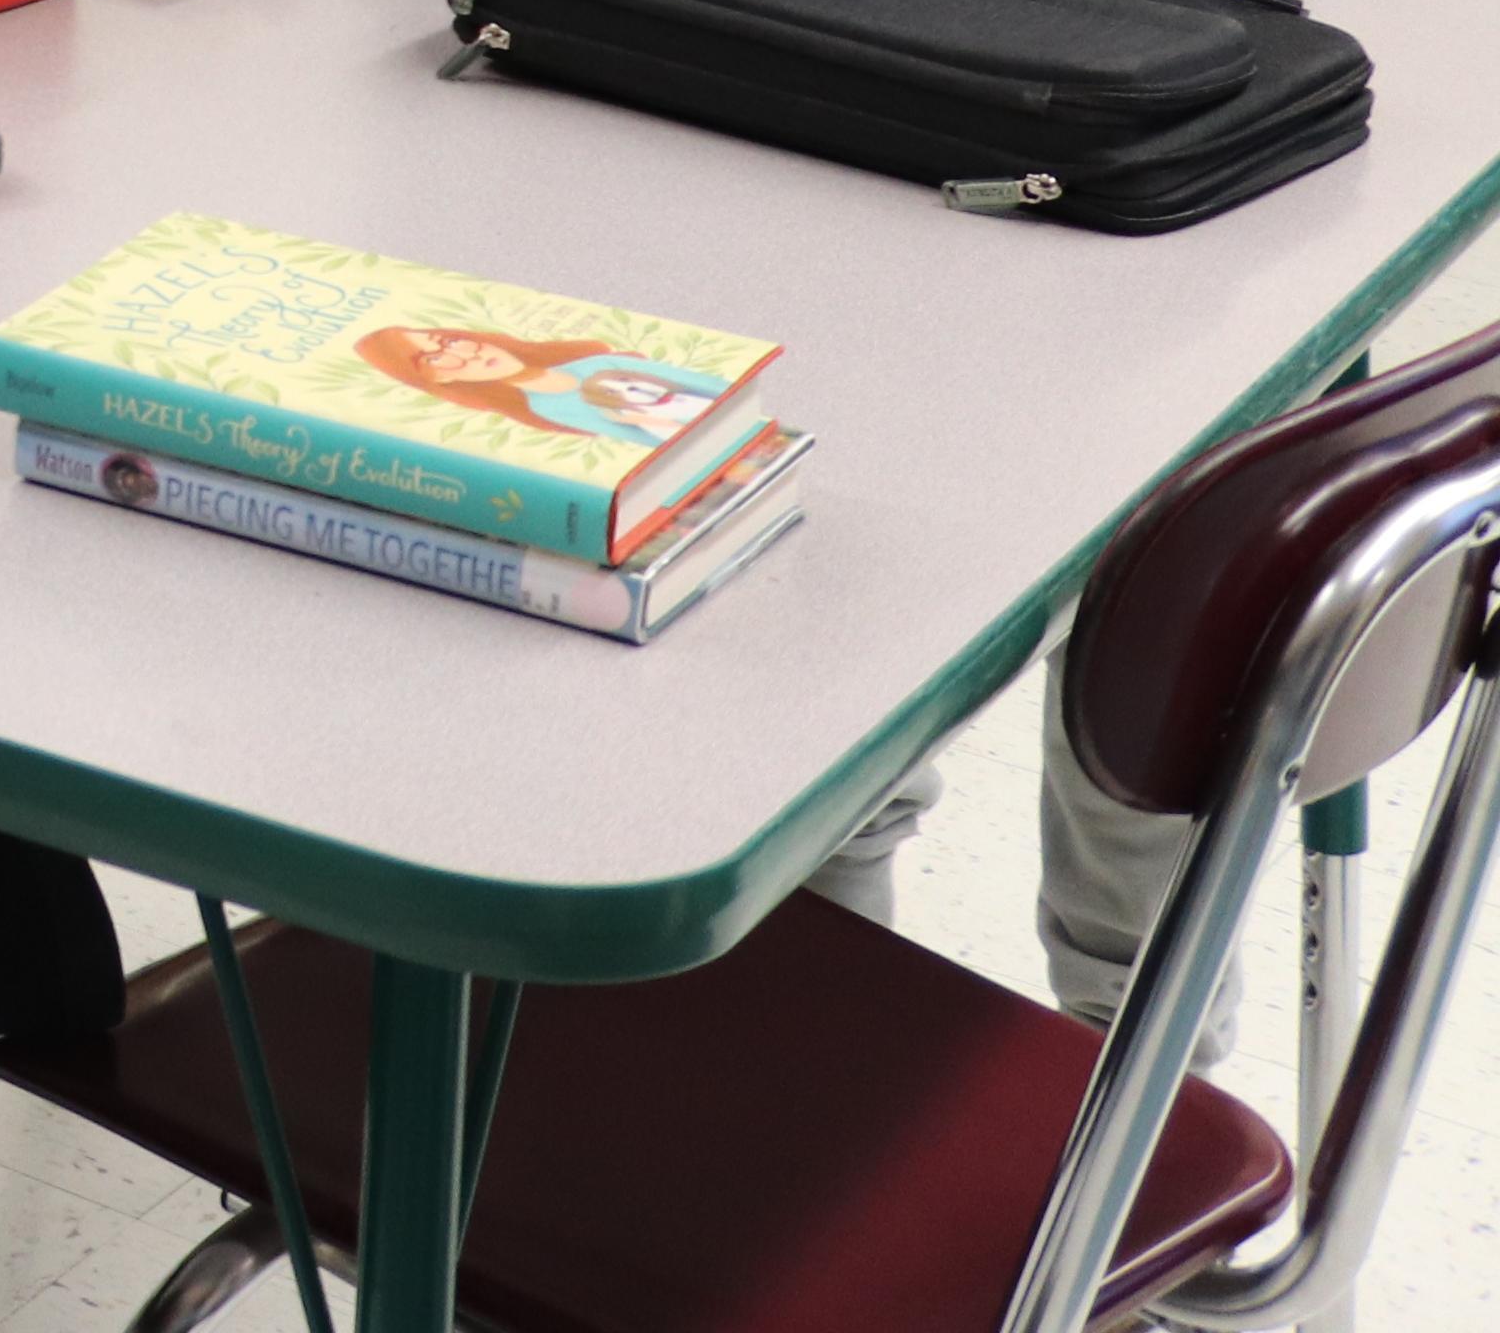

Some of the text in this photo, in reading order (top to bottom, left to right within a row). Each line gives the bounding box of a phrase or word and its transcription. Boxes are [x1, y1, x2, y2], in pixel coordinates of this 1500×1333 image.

[102, 245, 280, 335] HAZEL'S
[167, 284, 311, 351] Theory
[241, 285, 390, 364] Evolution
[102, 391, 216, 444] HAZEL'S
[216, 413, 311, 478] Theory
[348, 447, 467, 504] Evolution
[34, 443, 520, 601] Watson PIECING ME TOGETHE
